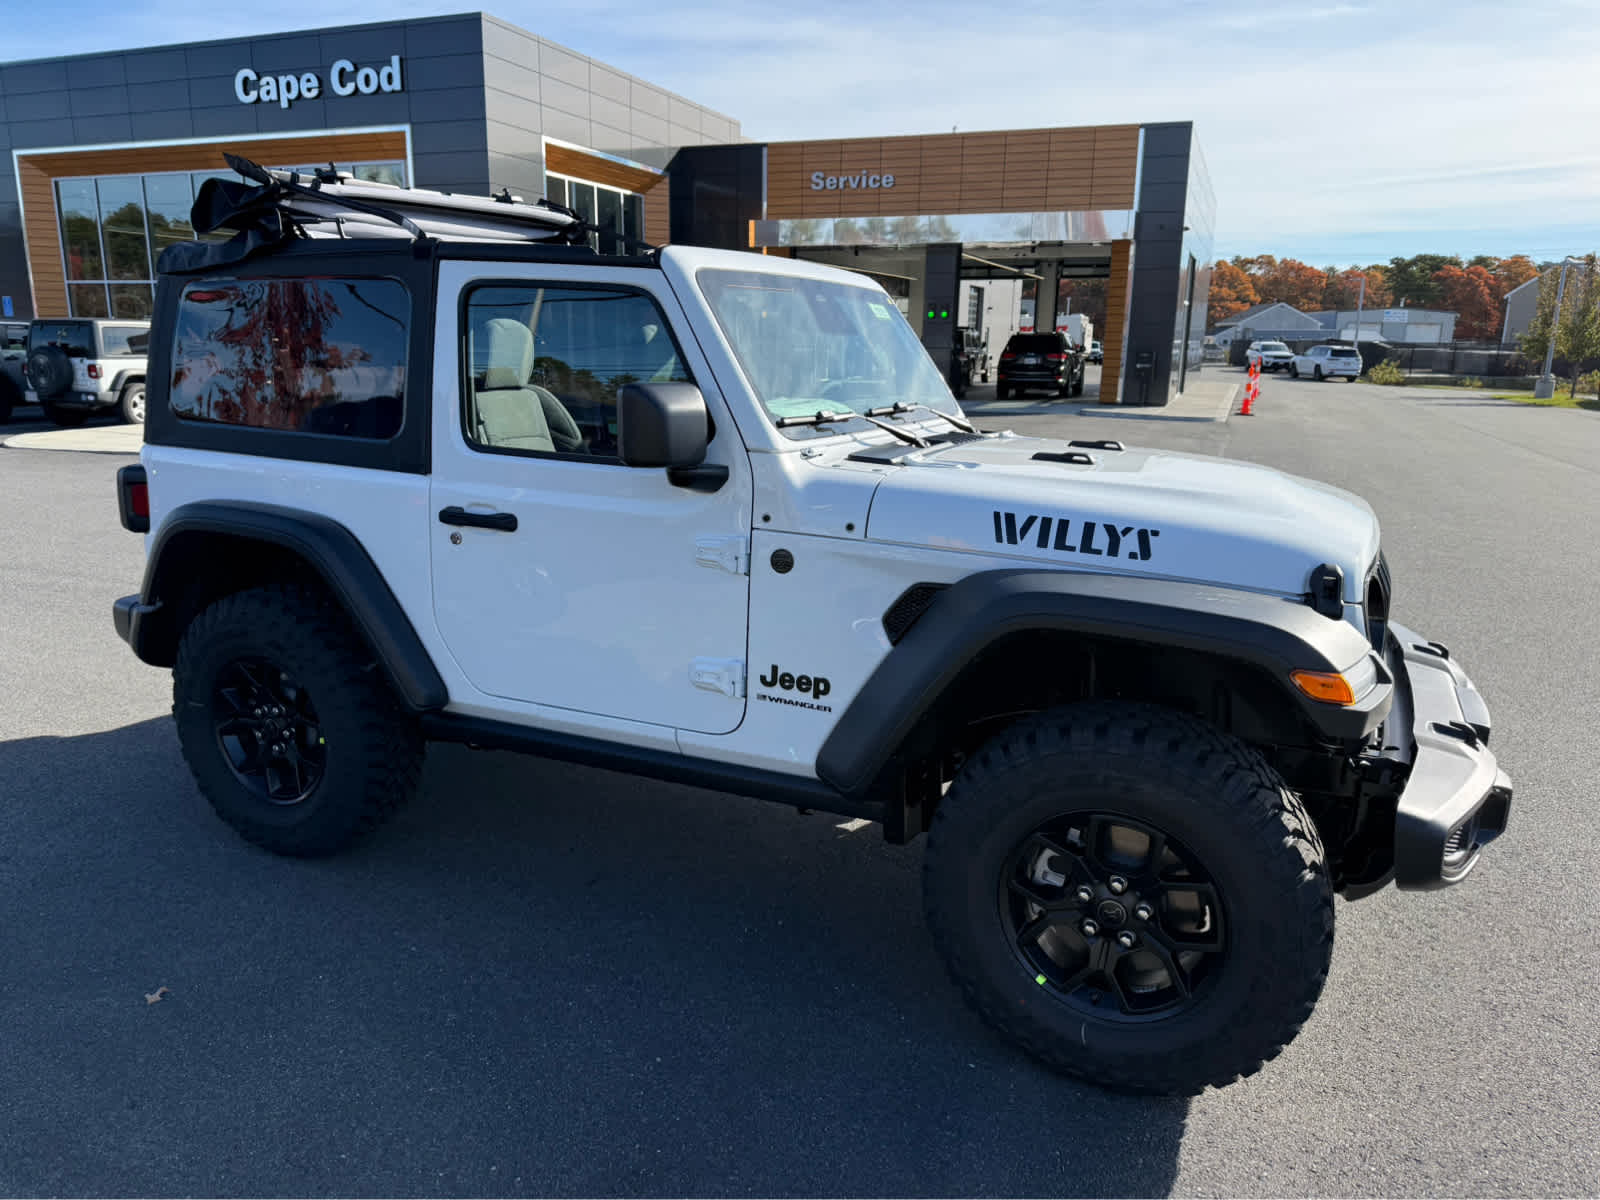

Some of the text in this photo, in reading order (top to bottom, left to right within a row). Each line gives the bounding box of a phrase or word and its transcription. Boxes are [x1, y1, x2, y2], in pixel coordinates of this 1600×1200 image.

[234, 55, 401, 109] Cape Cod
[811, 169, 895, 191] Service
[993, 511, 1160, 561] WILLYS
[759, 664, 831, 700] Jeep
[767, 695, 832, 713] WRANGLER
